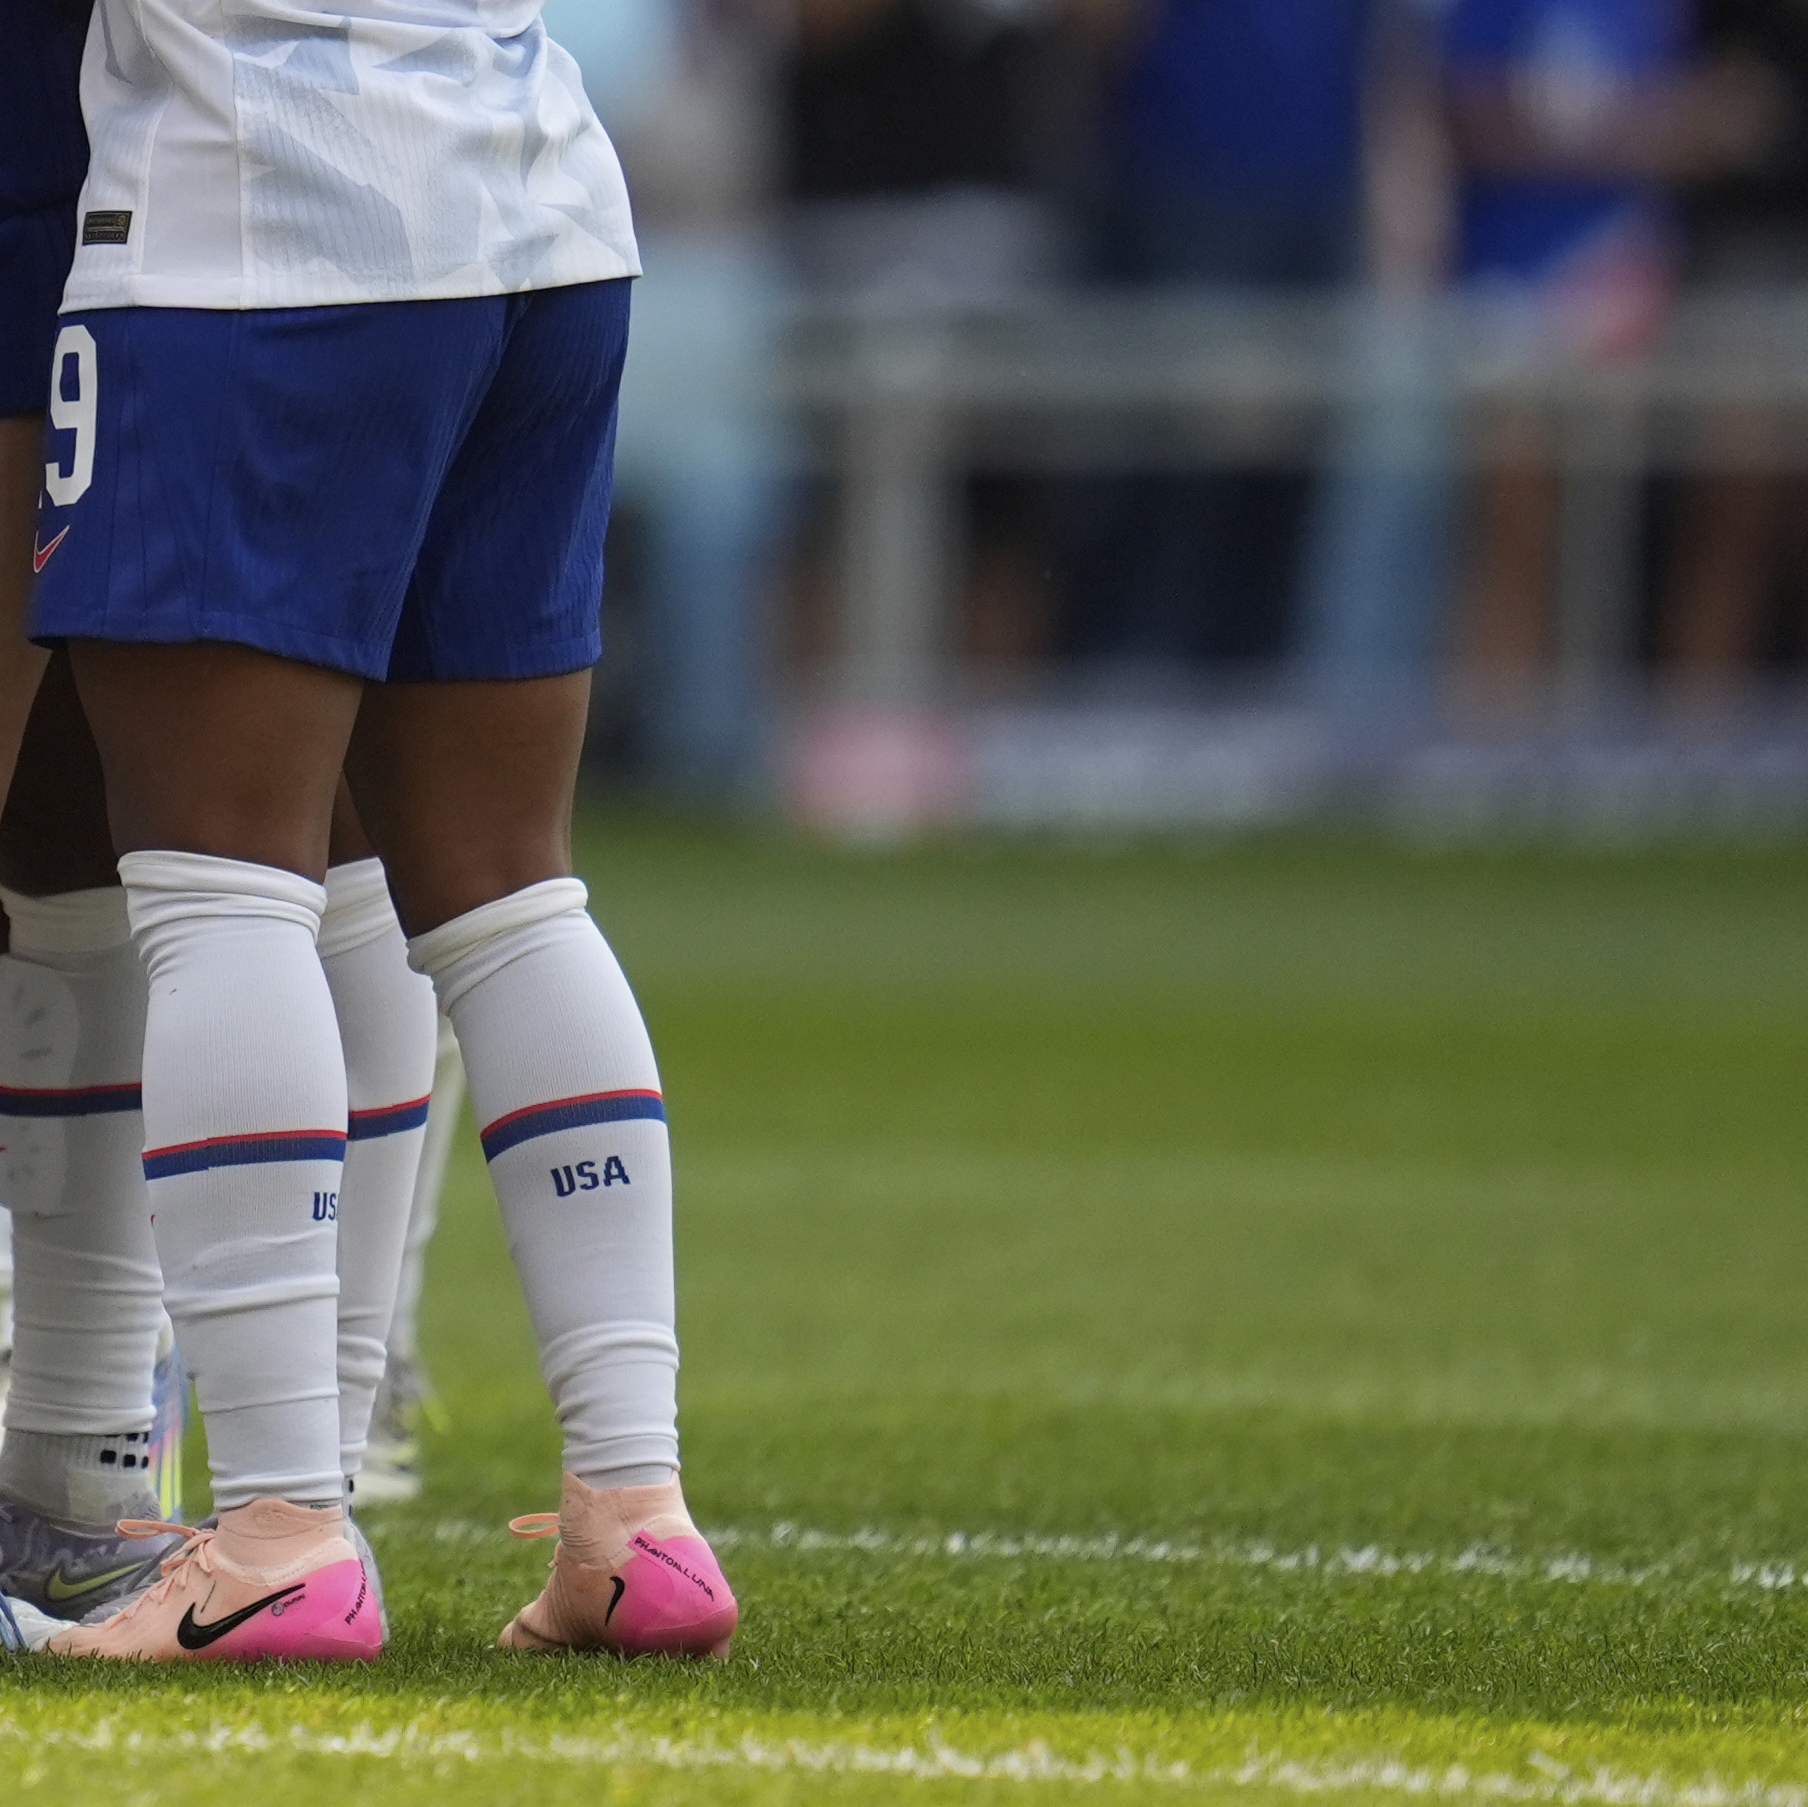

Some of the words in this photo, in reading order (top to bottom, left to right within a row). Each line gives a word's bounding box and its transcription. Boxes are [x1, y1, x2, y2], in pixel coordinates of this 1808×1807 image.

[38, 324, 98, 508] 9
[550, 1155, 631, 1198] USA
[312, 1191, 338, 1221] US
[634, 1537, 683, 1573] PHANTOM
